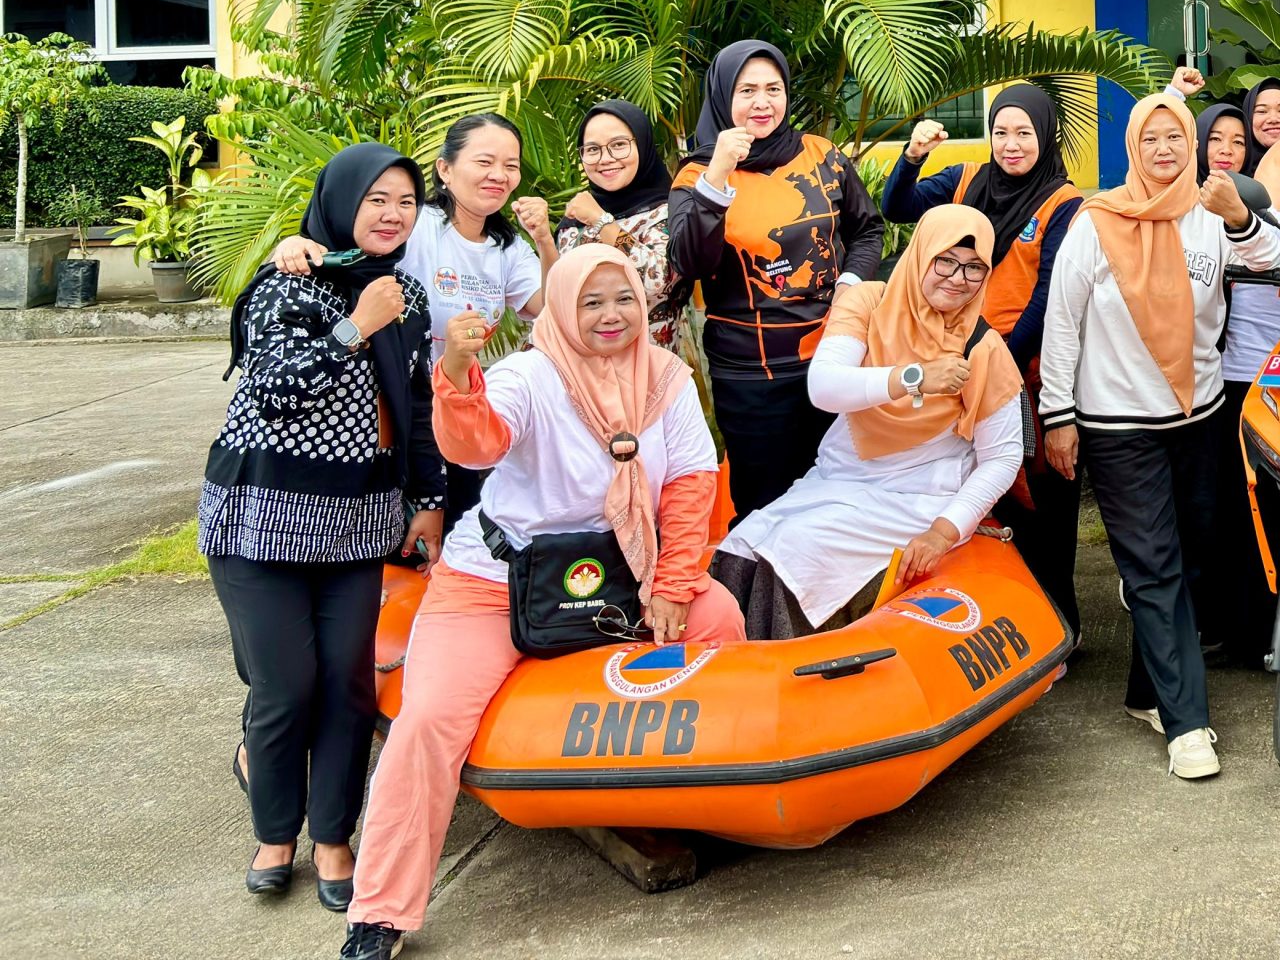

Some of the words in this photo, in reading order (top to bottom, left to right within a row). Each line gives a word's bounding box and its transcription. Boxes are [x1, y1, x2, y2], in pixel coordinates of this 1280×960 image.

[765, 259, 790, 270] BANGKA
[609, 654, 667, 694] PENANGGULANGAN
[948, 616, 1031, 692] BNPB
[561, 699, 700, 757] BNPB
